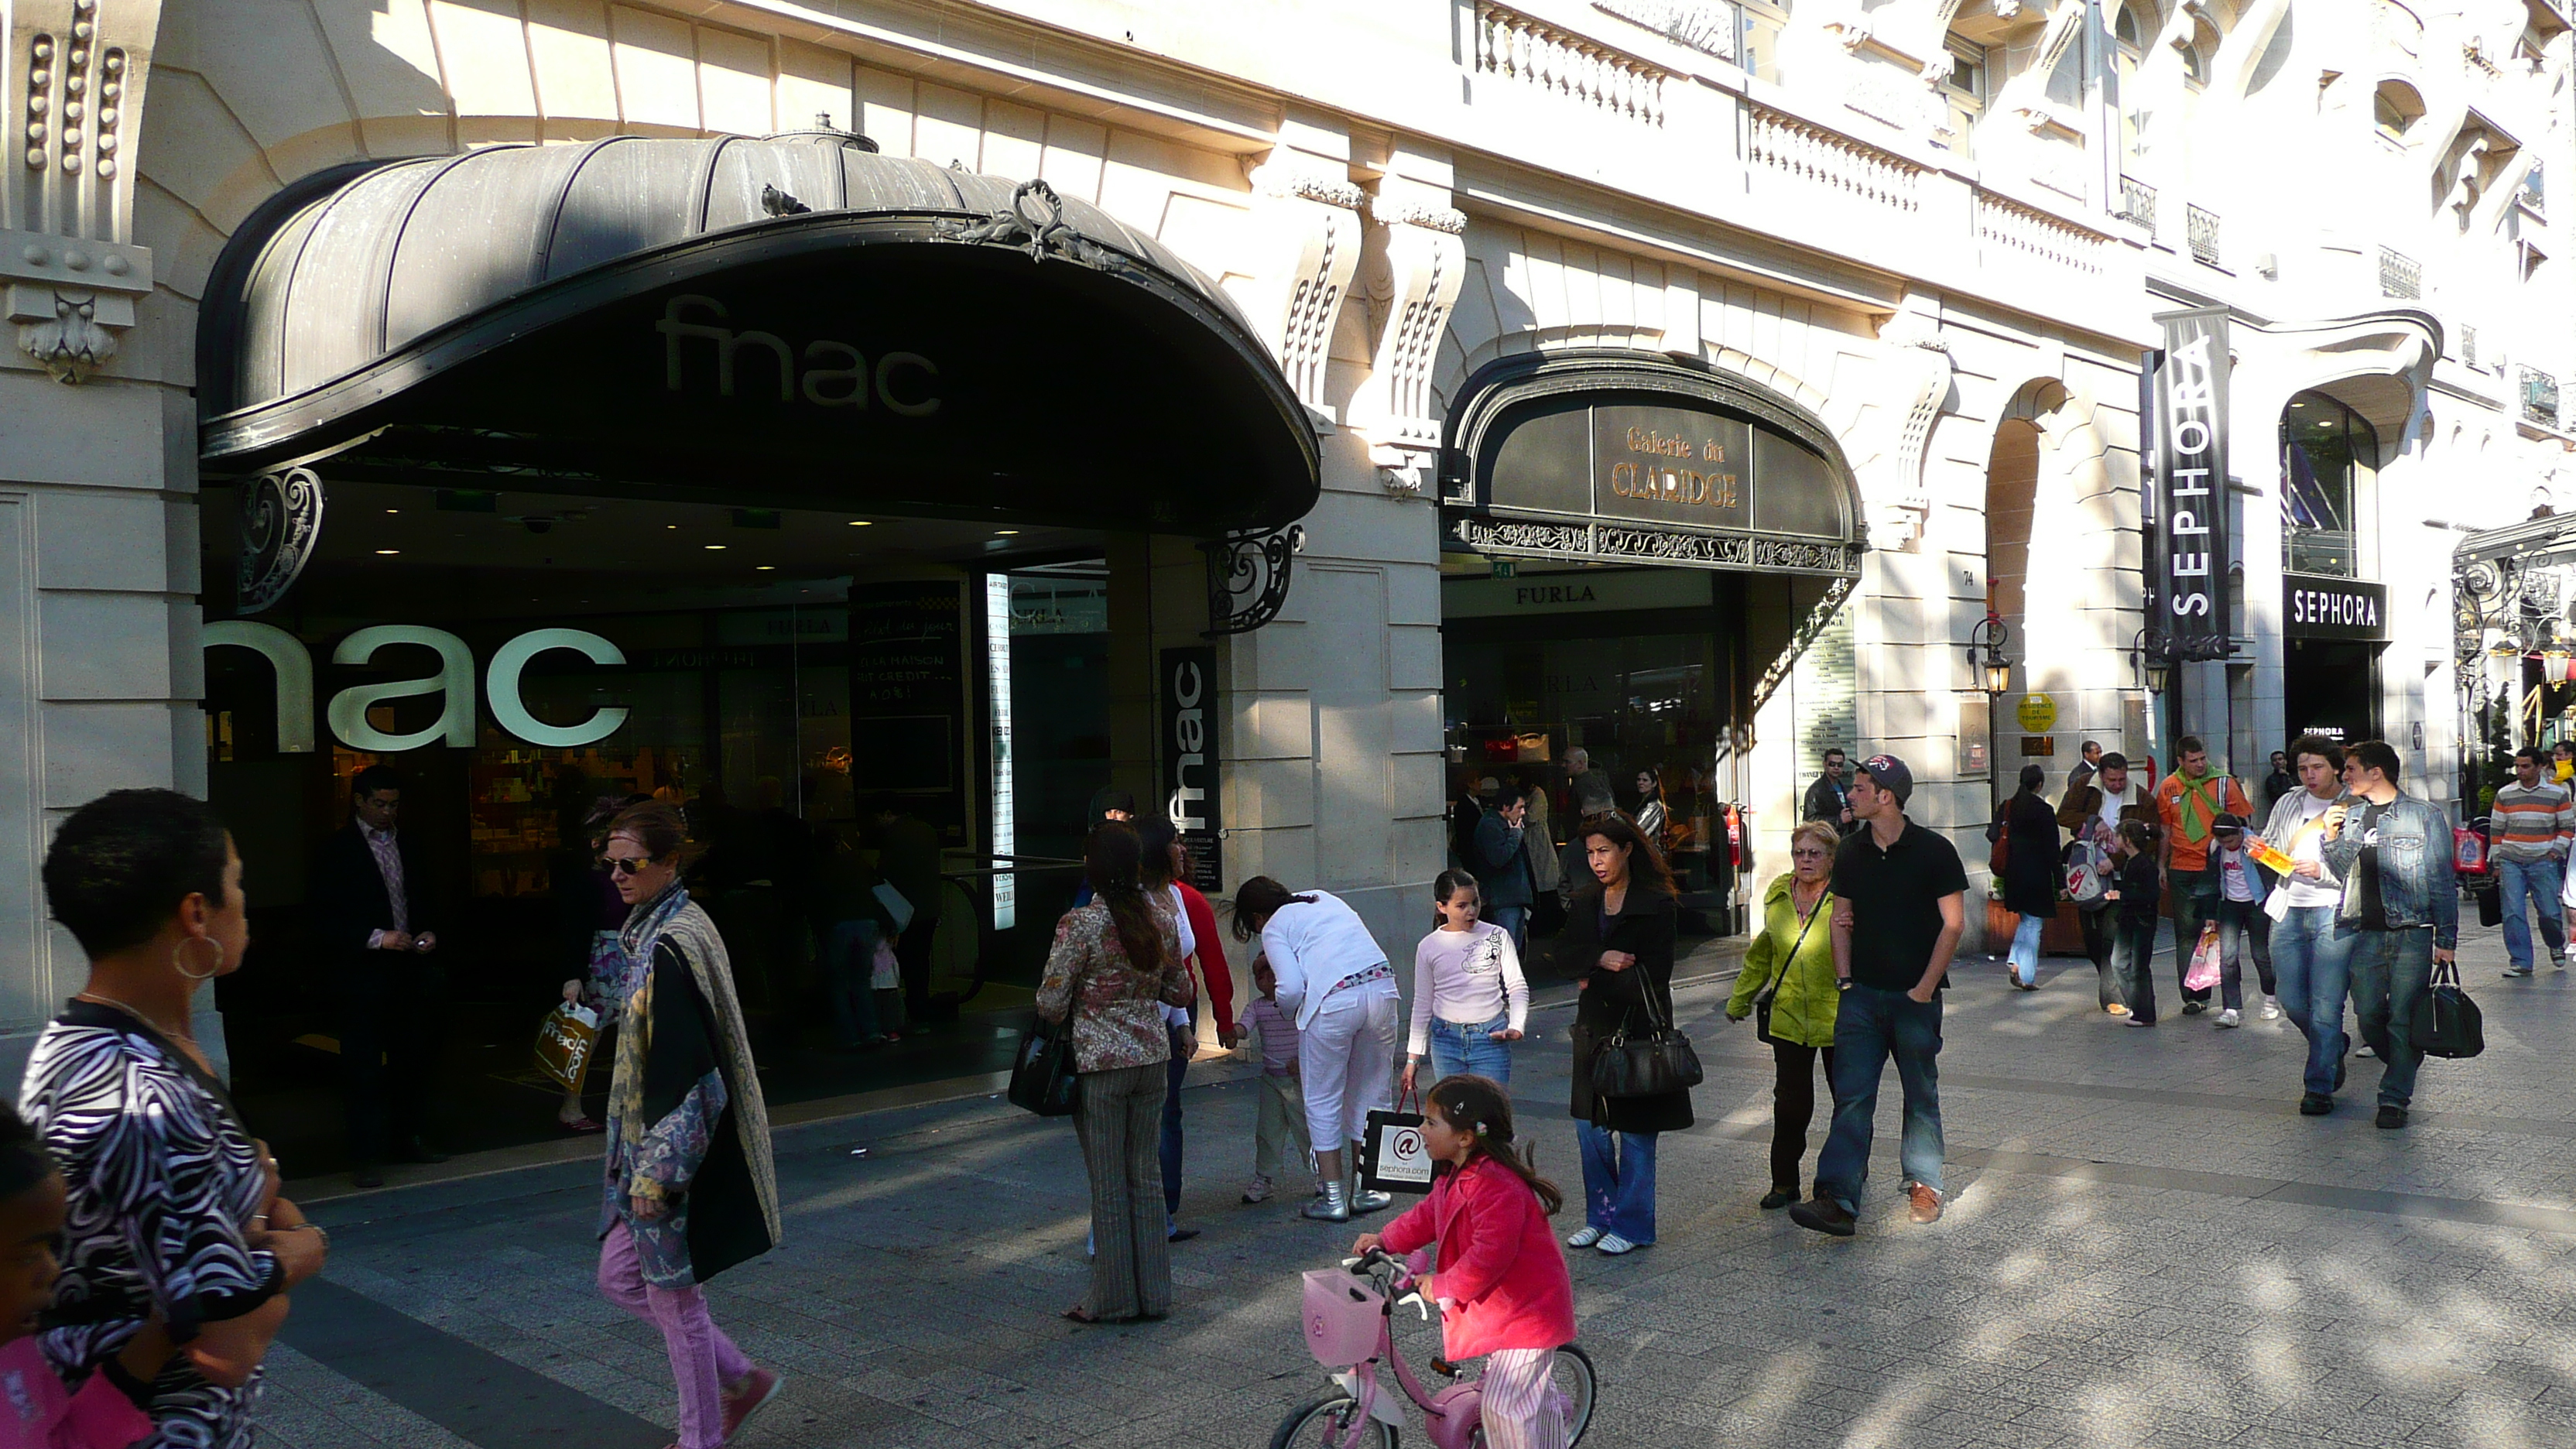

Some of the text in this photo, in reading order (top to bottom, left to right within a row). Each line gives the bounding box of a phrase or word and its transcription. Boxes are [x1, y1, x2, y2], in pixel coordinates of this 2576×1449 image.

[655, 293, 942, 418] fnac
[1627, 425, 1725, 464] Galerie du
[1612, 462, 1738, 509] CLARIDGE
[2172, 334, 2212, 617] SEPHORA
[1963, 570, 1974, 586] 74
[1515, 584, 1597, 605] FURLA
[2293, 589, 2377, 627] SEPHORA
[920, 617, 955, 643] jour
[890, 655, 944, 666] MAISON
[2303, 728, 2345, 736] SEPHORA
[1169, 659, 1207, 835] fnac
[545, 1021, 576, 1050] fnac
[1379, 1165, 1430, 1176] sephora.com
